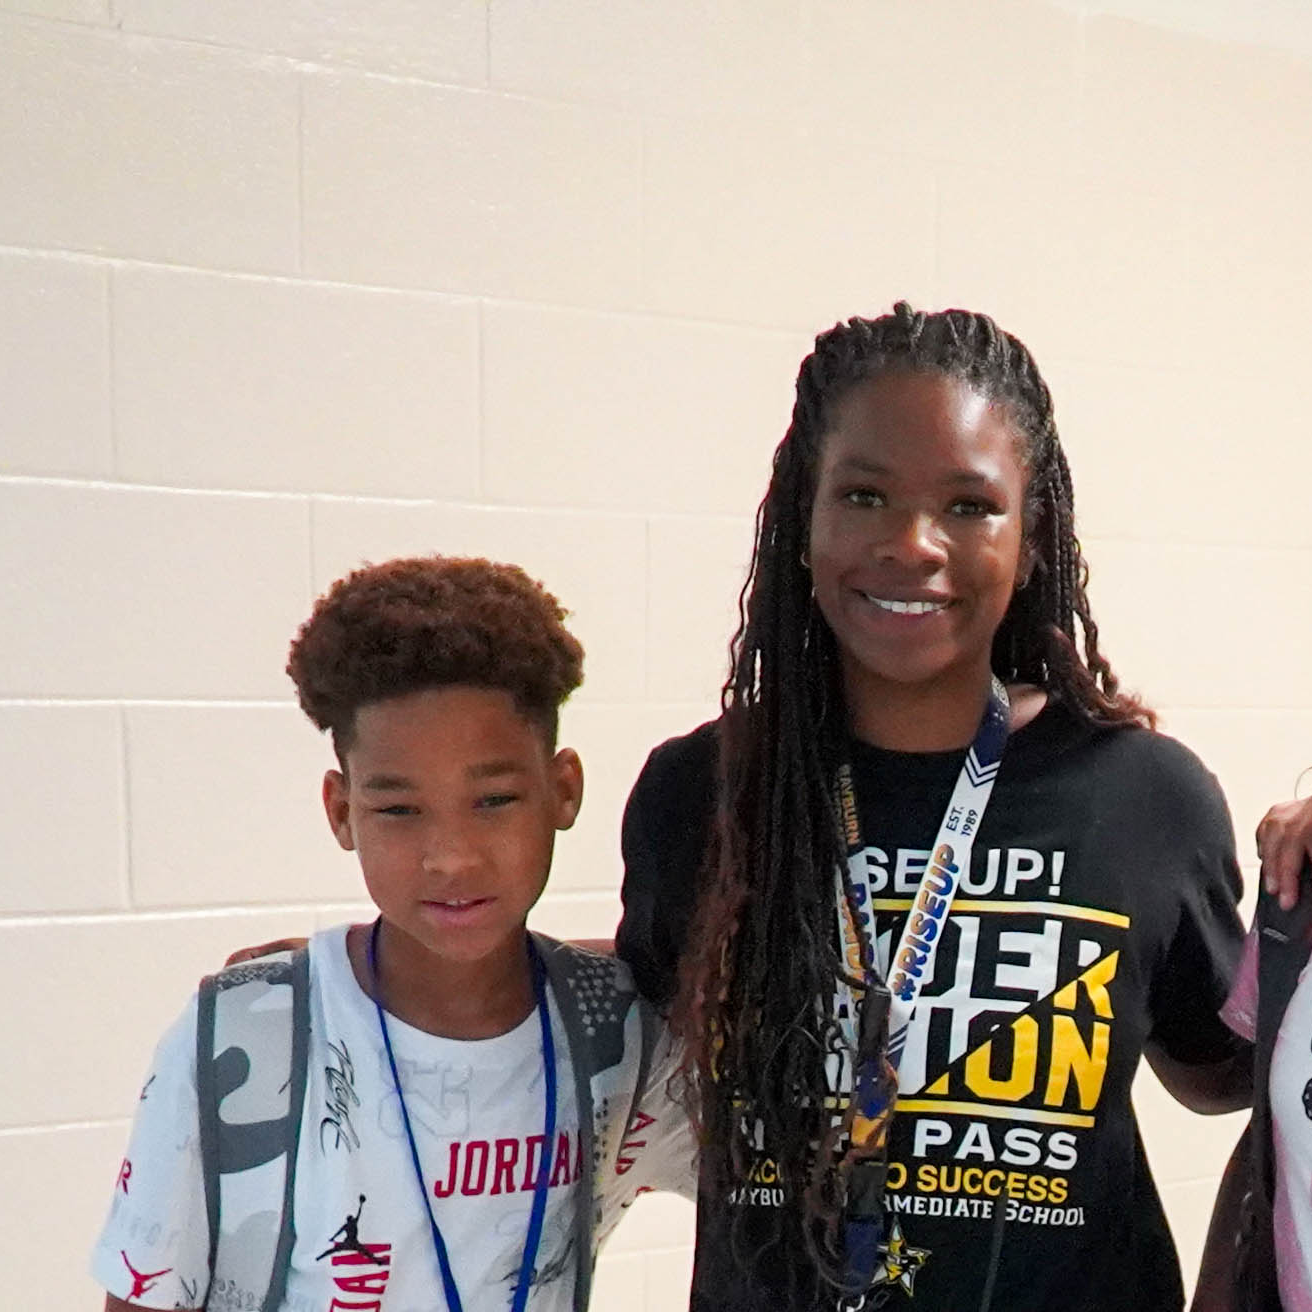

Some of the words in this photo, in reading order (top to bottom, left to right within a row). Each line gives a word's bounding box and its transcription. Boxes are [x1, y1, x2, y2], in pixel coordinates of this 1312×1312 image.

[946, 806, 965, 831] EST.
[960, 809, 979, 837] 1989
[958, 847, 1066, 897] UP!
[894, 843, 960, 1001] #RISEUP
[912, 1118, 1079, 1171] PASS
[916, 1163, 1069, 1204] SUCCESS
[884, 1194, 994, 1220] MEDIATE
